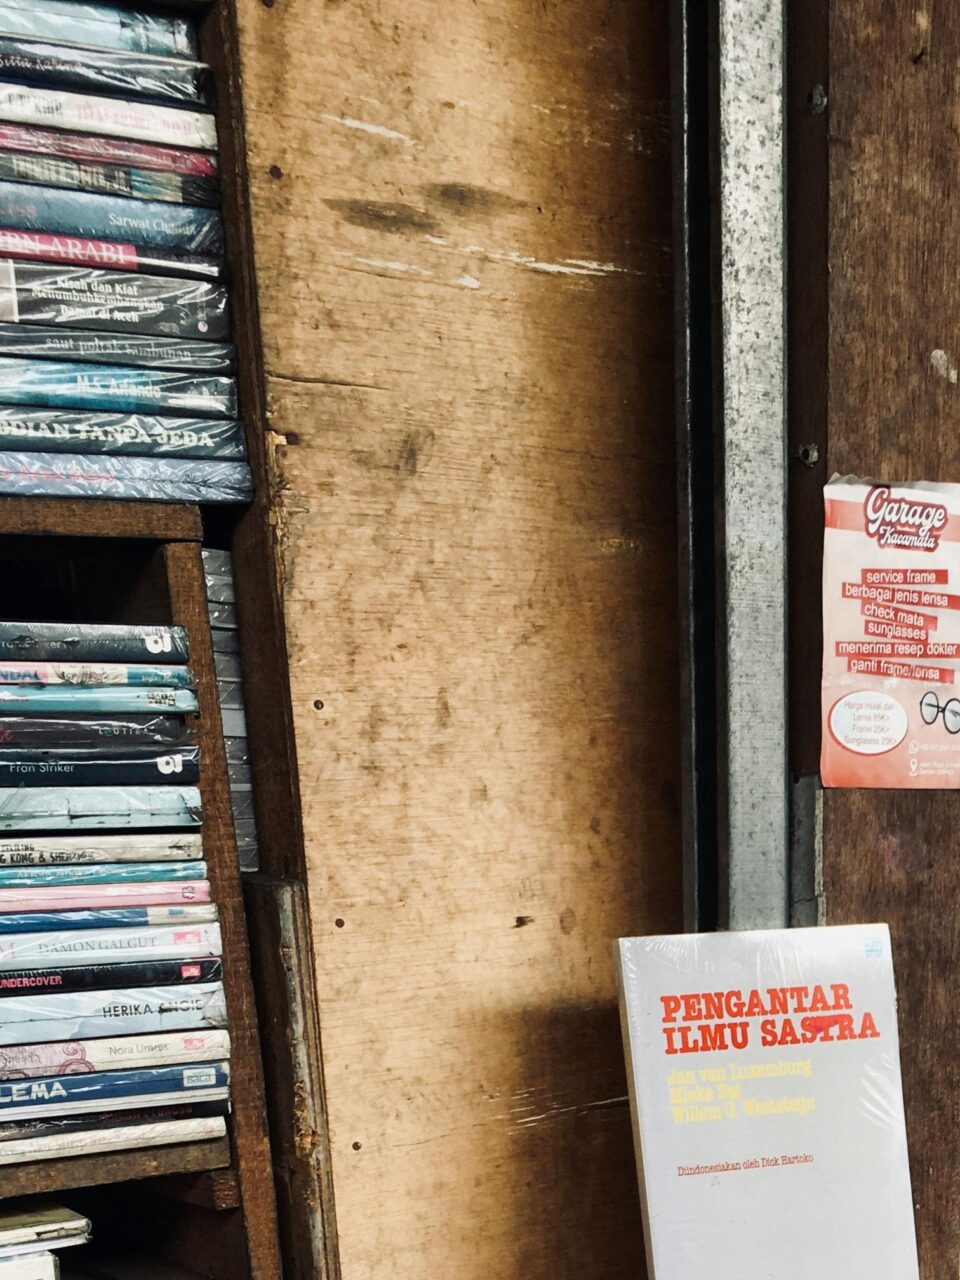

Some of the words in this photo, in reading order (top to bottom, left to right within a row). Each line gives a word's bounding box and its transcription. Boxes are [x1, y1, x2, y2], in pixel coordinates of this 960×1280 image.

[50, 239, 125, 263] ARABI
[156, 430, 214, 446] JEDA
[866, 487, 946, 536] Garage
[880, 526, 936, 549] Kacamata
[866, 571, 904, 583] service
[907, 571, 936, 583] frame
[839, 643, 892, 654] menerima
[894, 643, 924, 657] resep
[9, 763, 35, 773] Fran
[103, 1004, 152, 1018] HERIKA
[661, 983, 852, 1023] PENGANTAR
[664, 1022, 748, 1055] ILMU
[761, 1013, 880, 1047] SASTRA
[743, 1160, 760, 1170] oleh
[781, 1154, 814, 1166] Hartoko
